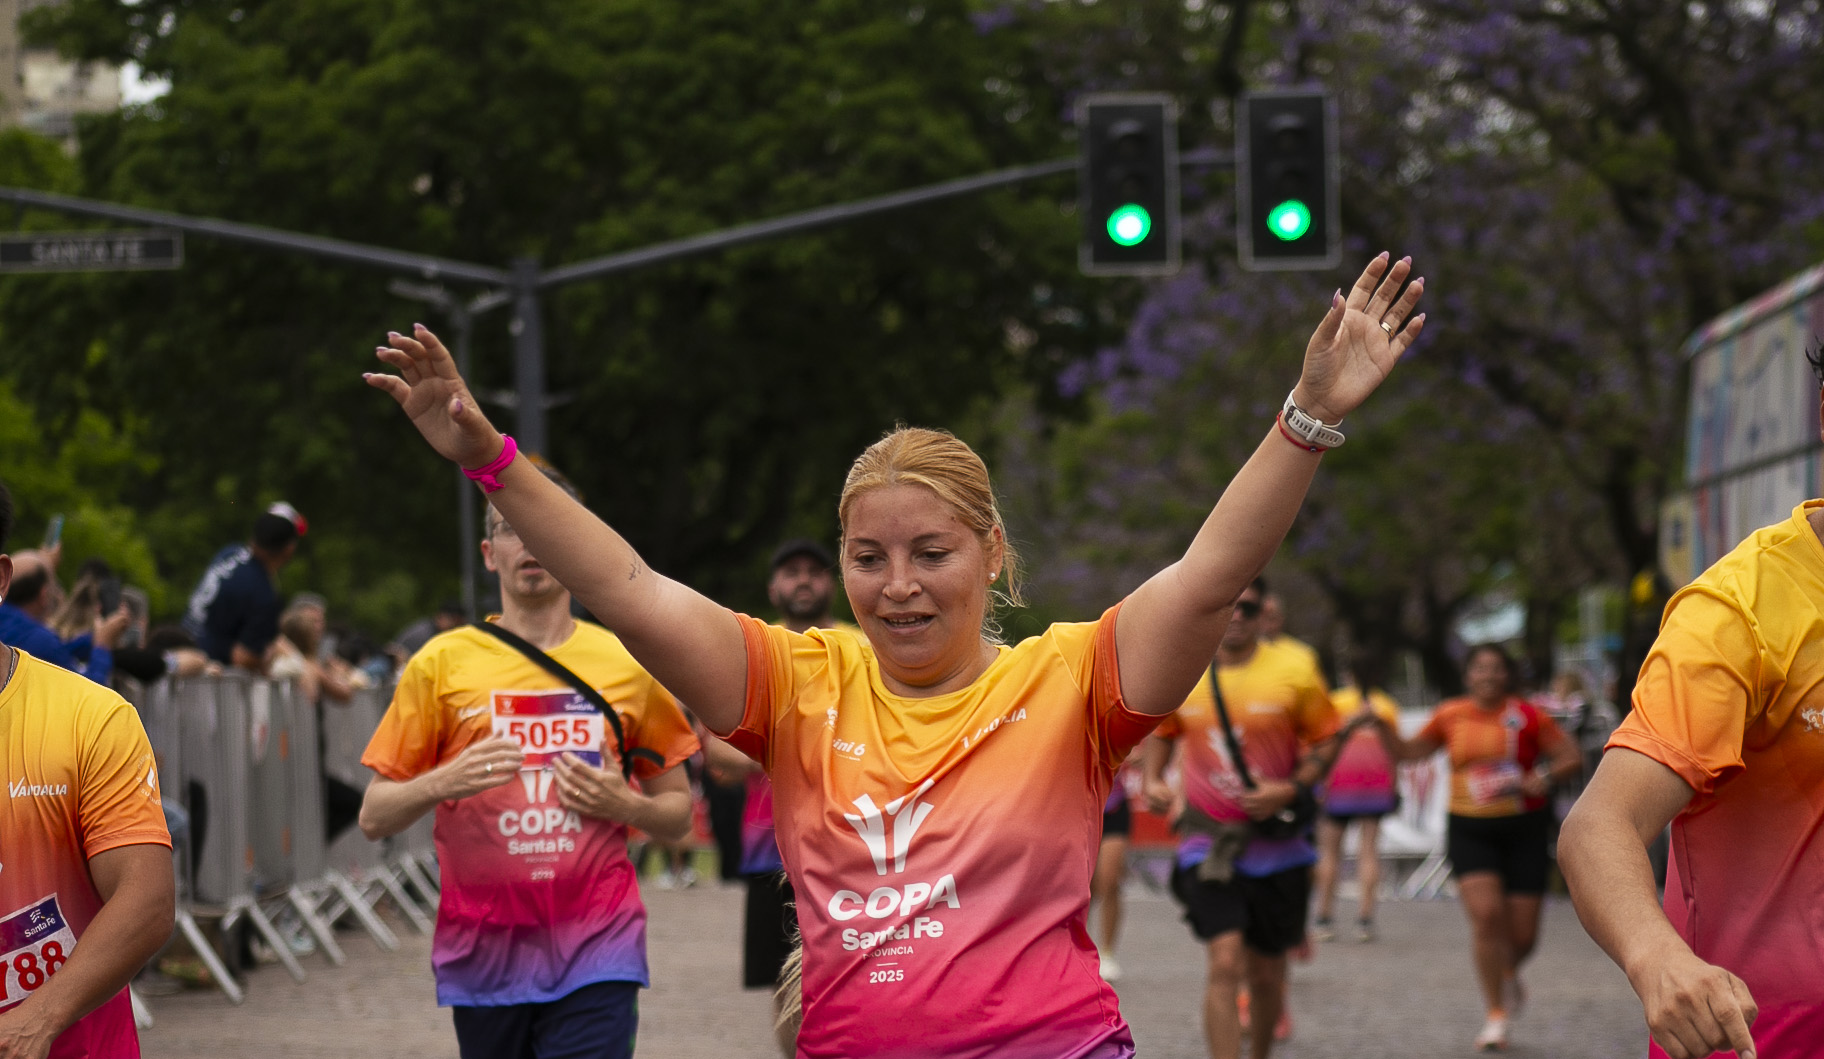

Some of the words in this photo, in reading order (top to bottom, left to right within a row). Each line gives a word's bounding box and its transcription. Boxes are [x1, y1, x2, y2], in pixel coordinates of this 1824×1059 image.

[508, 719, 591, 750] 5055
[499, 808, 582, 837] COPA
[508, 840, 556, 855] Santa
[557, 837, 575, 853] Fe
[827, 873, 961, 921] COPA
[24, 921, 47, 938] Santa
[45, 915, 56, 927] Fe
[842, 923, 910, 951] Santa
[913, 917, 944, 939] Fe
[869, 970, 904, 984] 2025
